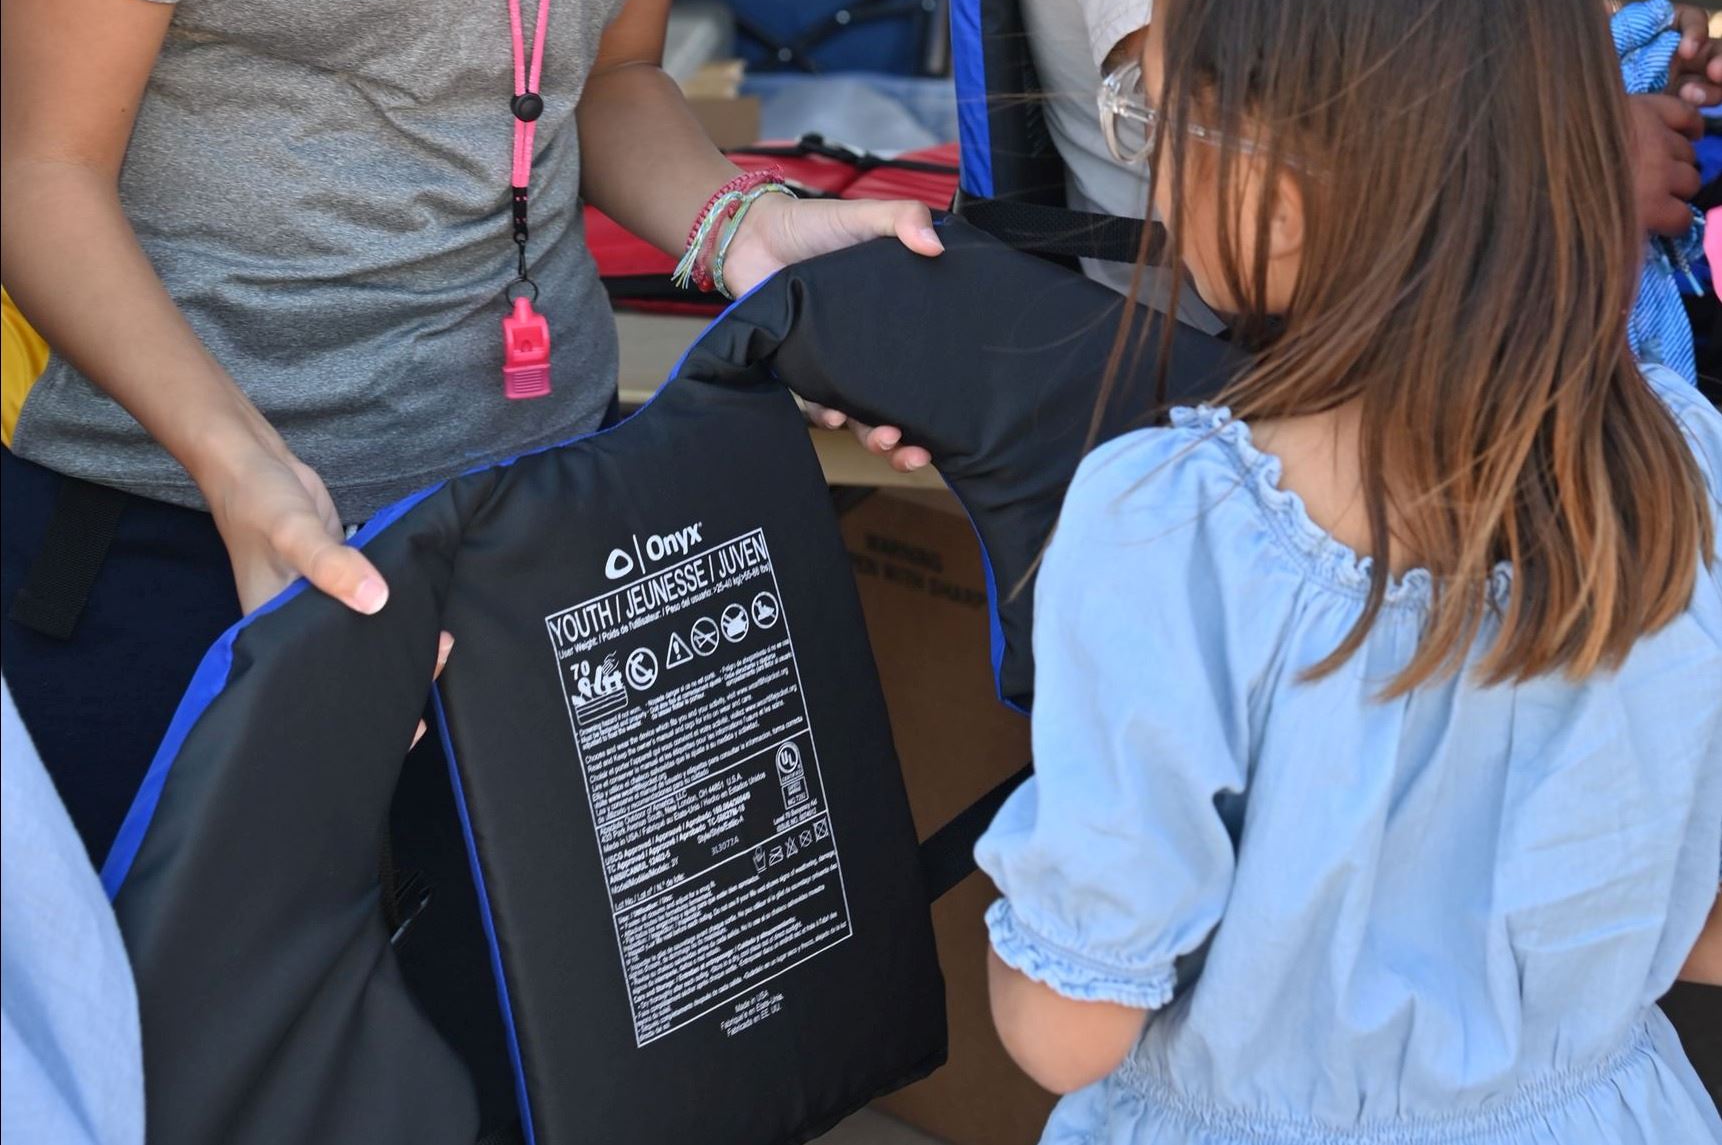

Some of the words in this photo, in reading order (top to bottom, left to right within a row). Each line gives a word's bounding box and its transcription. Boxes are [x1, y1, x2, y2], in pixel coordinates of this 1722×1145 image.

[646, 523, 702, 561] Onyx
[549, 600, 613, 646] YOUTH
[626, 560, 708, 617] JEUNESSE
[719, 534, 767, 578] JUVEN
[570, 660, 590, 680] 70
[781, 749, 796, 765] UL
